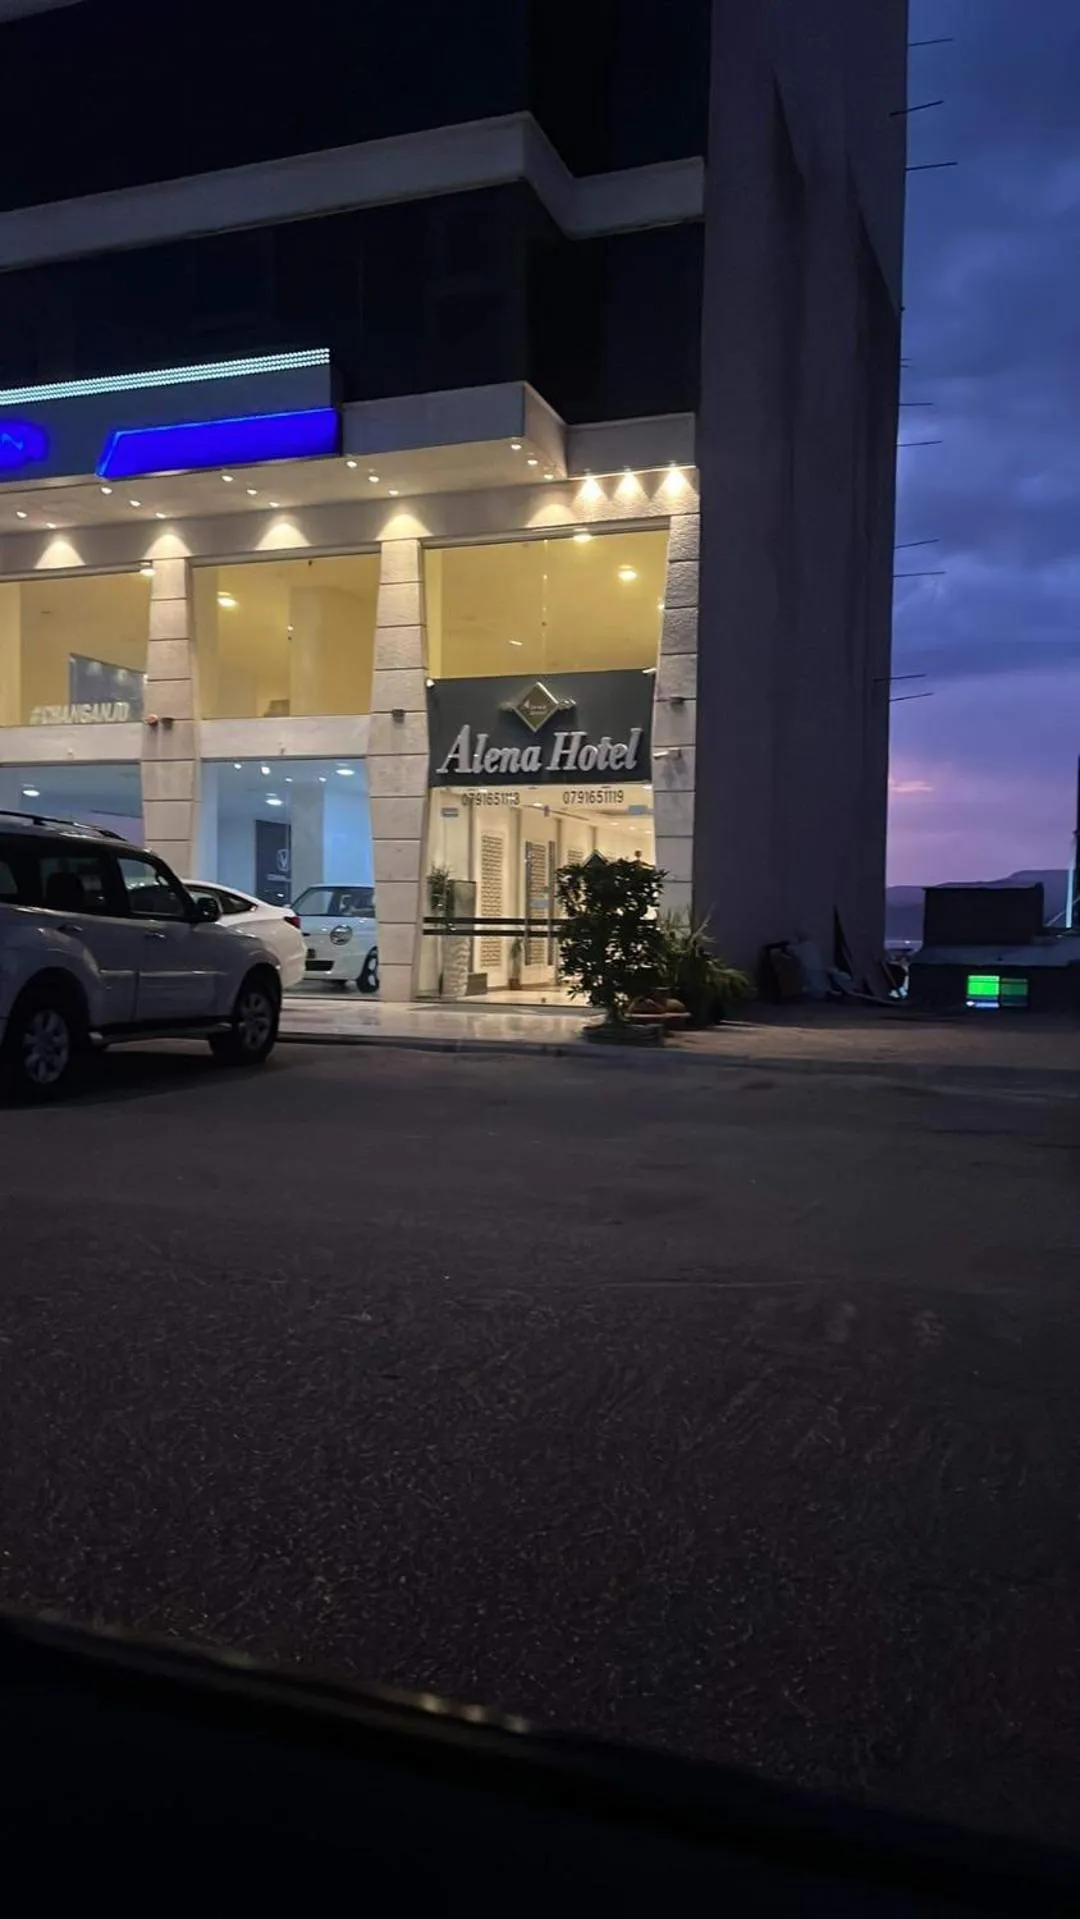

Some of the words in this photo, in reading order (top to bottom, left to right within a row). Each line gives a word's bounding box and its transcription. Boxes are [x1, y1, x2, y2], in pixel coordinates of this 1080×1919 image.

[436, 724, 541, 773] Alena
[546, 728, 643, 770] Hotel
[562, 789, 624, 805] 0791651119
